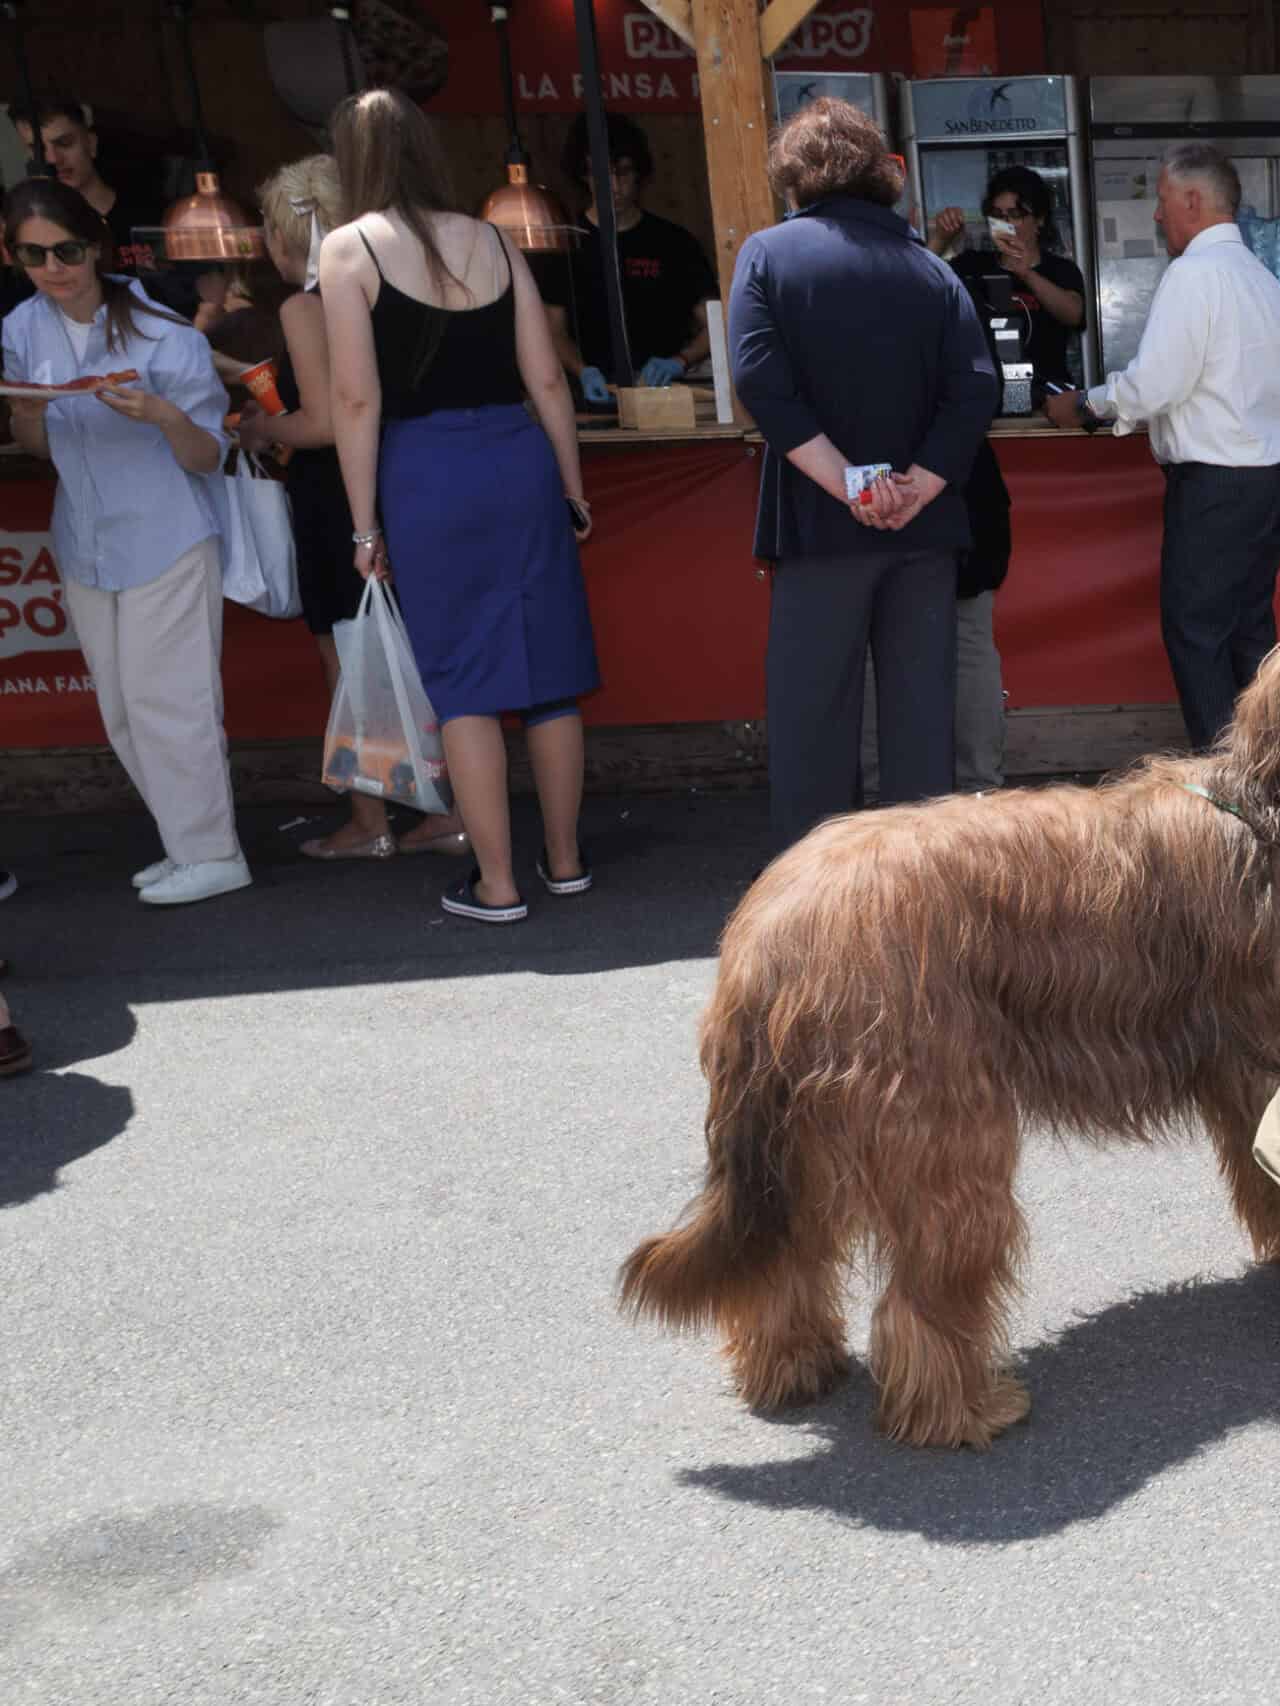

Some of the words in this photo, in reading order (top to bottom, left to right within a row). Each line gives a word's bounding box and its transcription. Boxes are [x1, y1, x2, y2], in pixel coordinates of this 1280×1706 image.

[518, 72, 559, 99] LA
[572, 72, 680, 99] PNSA
[0, 676, 49, 696] ANA
